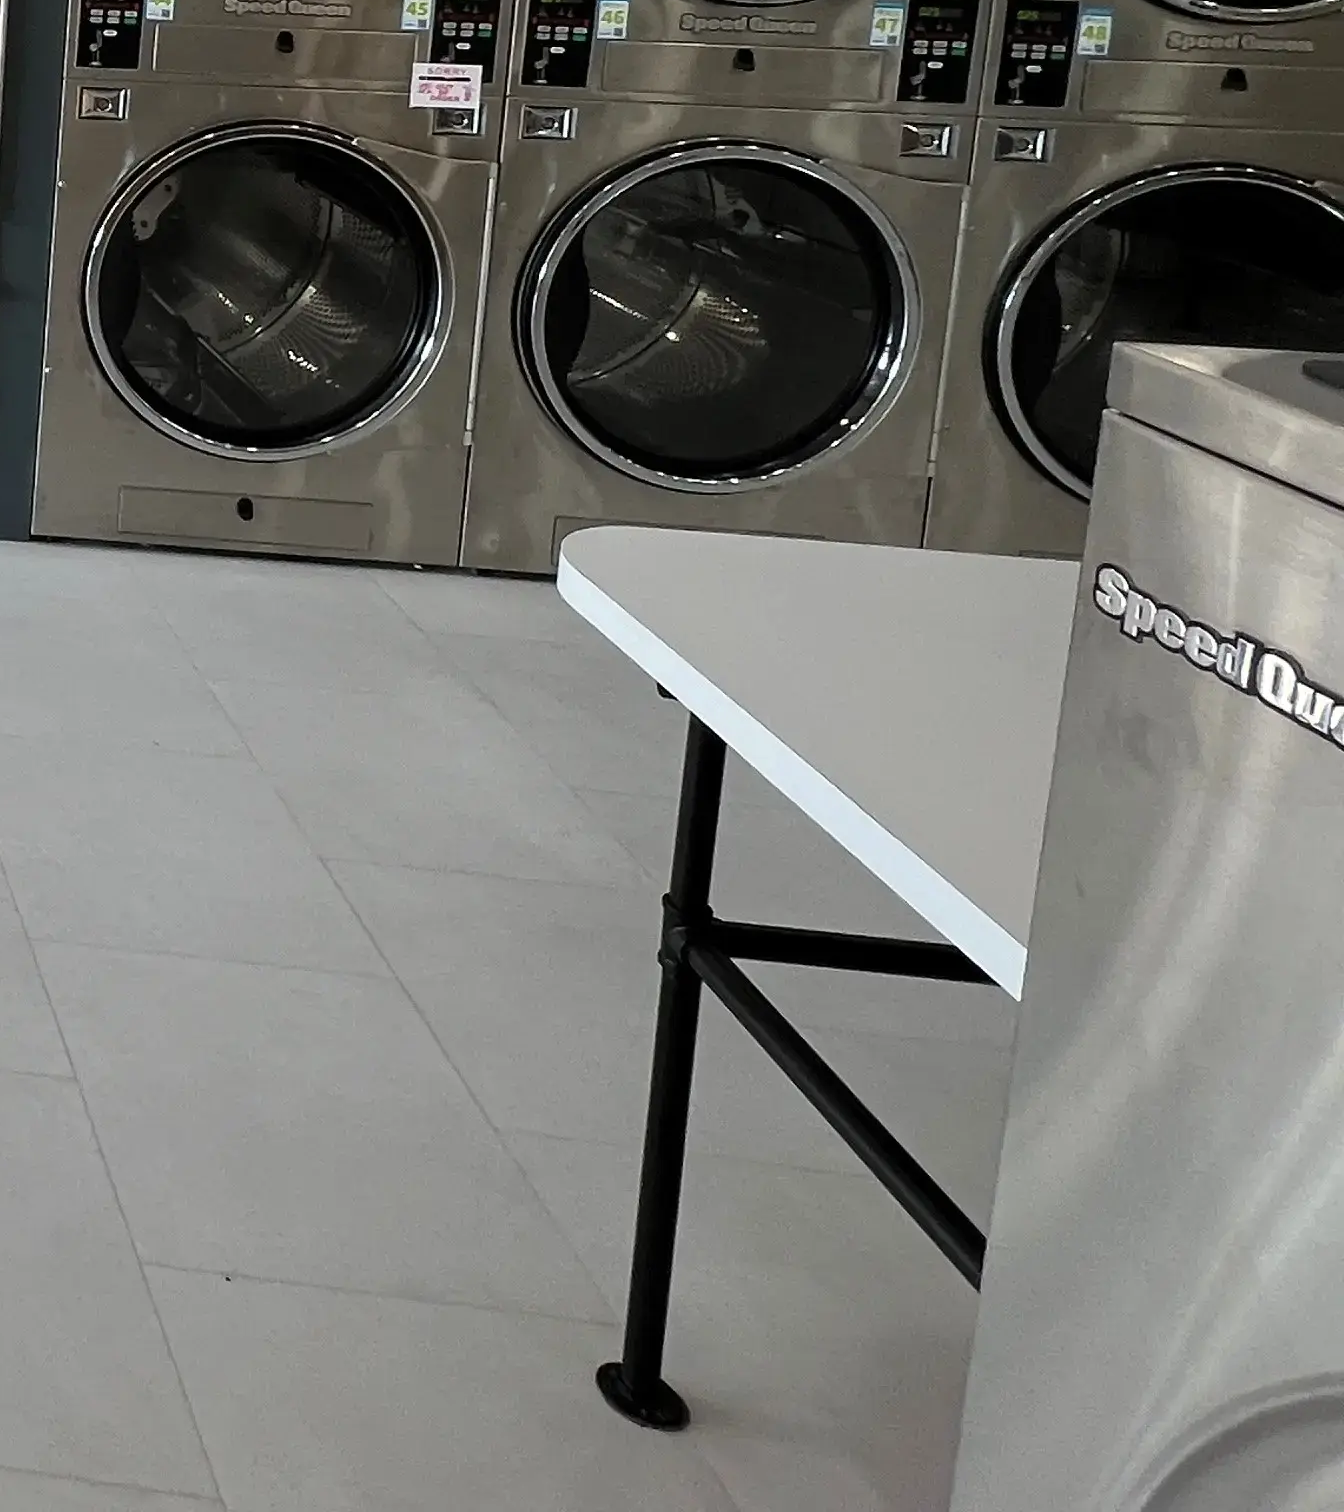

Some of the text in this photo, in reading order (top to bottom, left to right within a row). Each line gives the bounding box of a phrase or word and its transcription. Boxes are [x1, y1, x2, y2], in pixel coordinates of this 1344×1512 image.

[405, 1, 429, 16] 45
[600, 10, 625, 25] 46
[679, 13, 747, 32] Speed
[874, 18, 899, 33] 47
[1082, 24, 1109, 41] 48
[1165, 30, 1240, 50] Speed
[1093, 563, 1259, 696] Speed
